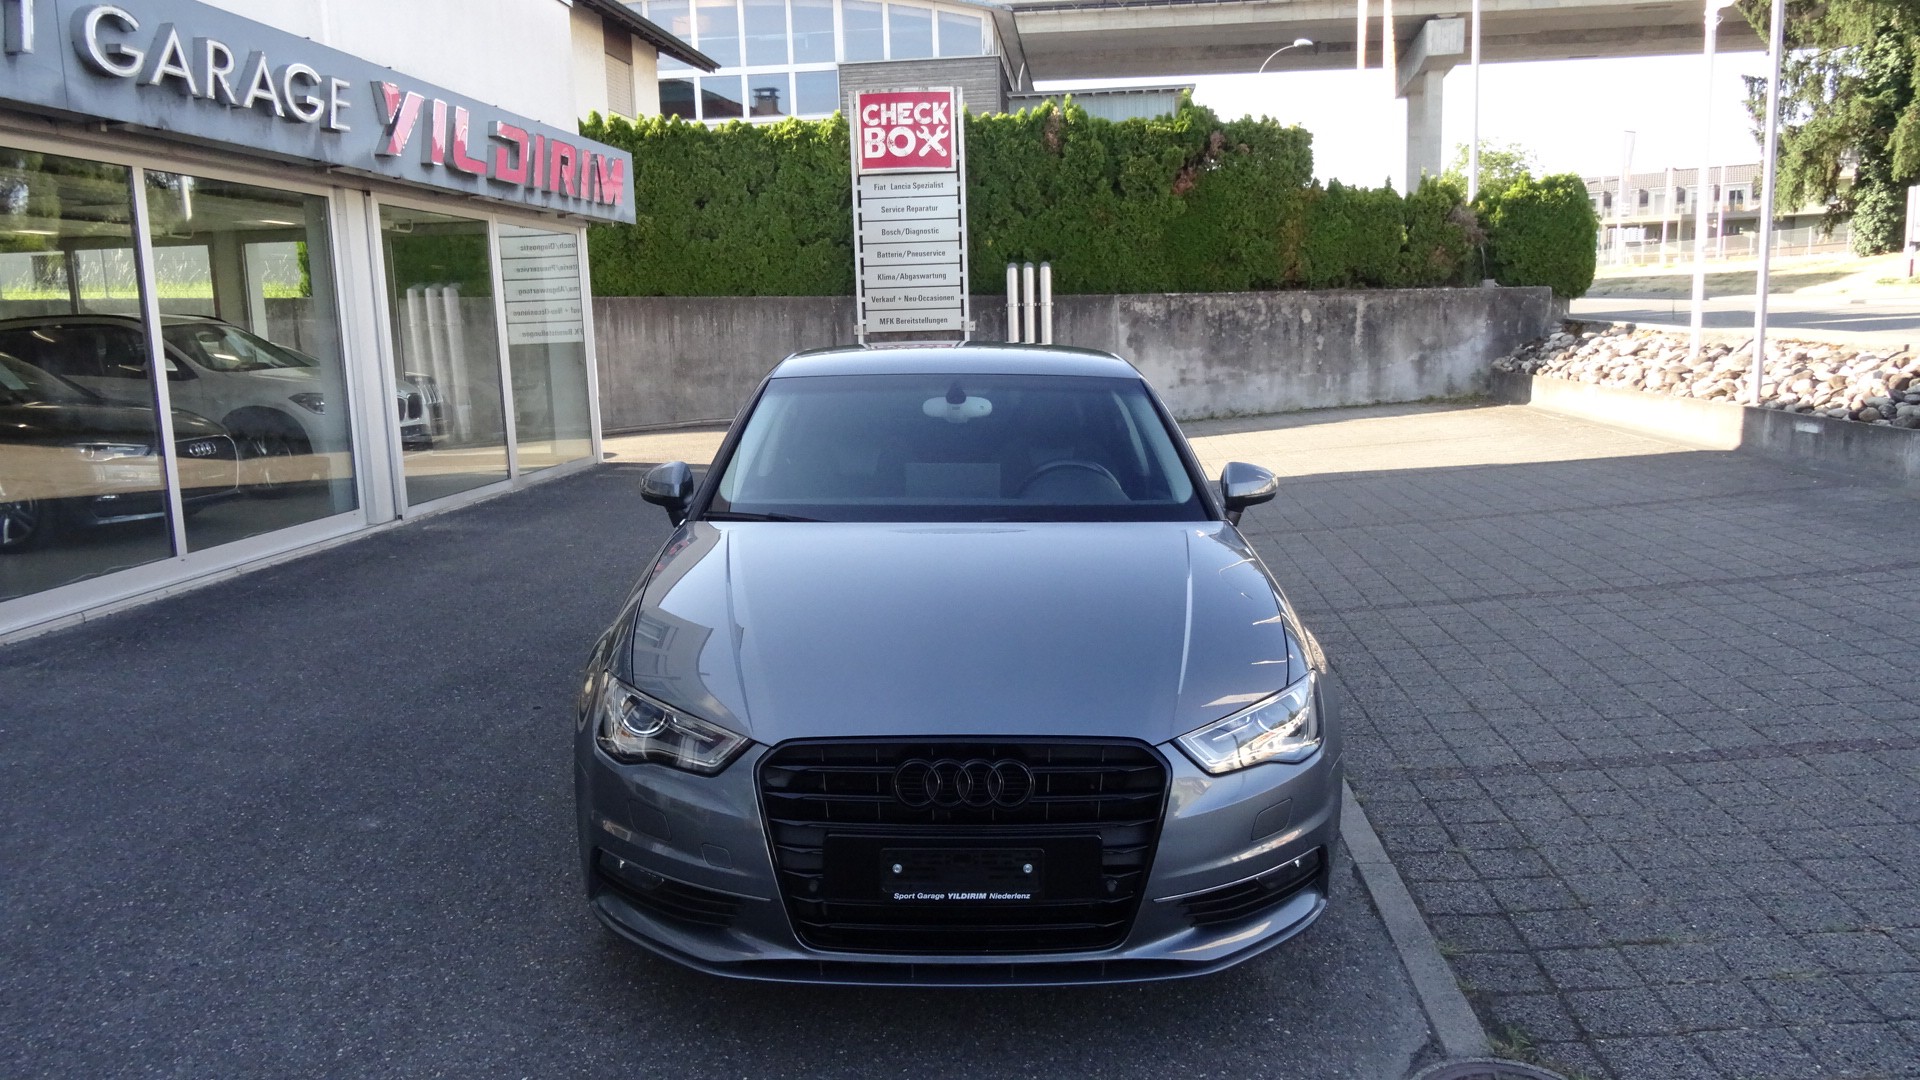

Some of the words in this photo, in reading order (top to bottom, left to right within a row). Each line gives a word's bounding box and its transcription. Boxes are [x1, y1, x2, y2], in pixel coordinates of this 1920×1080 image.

[70, 4, 352, 132] GARAGE
[371, 80, 625, 206] YILDIRIM
[862, 102, 949, 126] CHECK
[863, 125, 949, 159] BOX
[873, 183, 886, 191] Fiat
[890, 182, 911, 190] Lancia
[912, 181, 944, 190] Spezialist
[881, 205, 905, 214] Service
[906, 204, 938, 214] Reparatur
[881, 226, 940, 236] Bosch/Diagnostic
[876, 249, 946, 259] Batterie/Pneuservice
[877, 272, 947, 281] Klima/Abgaswartung
[871, 295, 896, 303] Verkauf
[903, 294, 955, 302] Neu-Occasionen
[879, 317, 895, 325] MFK
[895, 316, 948, 325] Bereitstellungen
[893, 892, 915, 900] Sport
[917, 892, 945, 900] Garage
